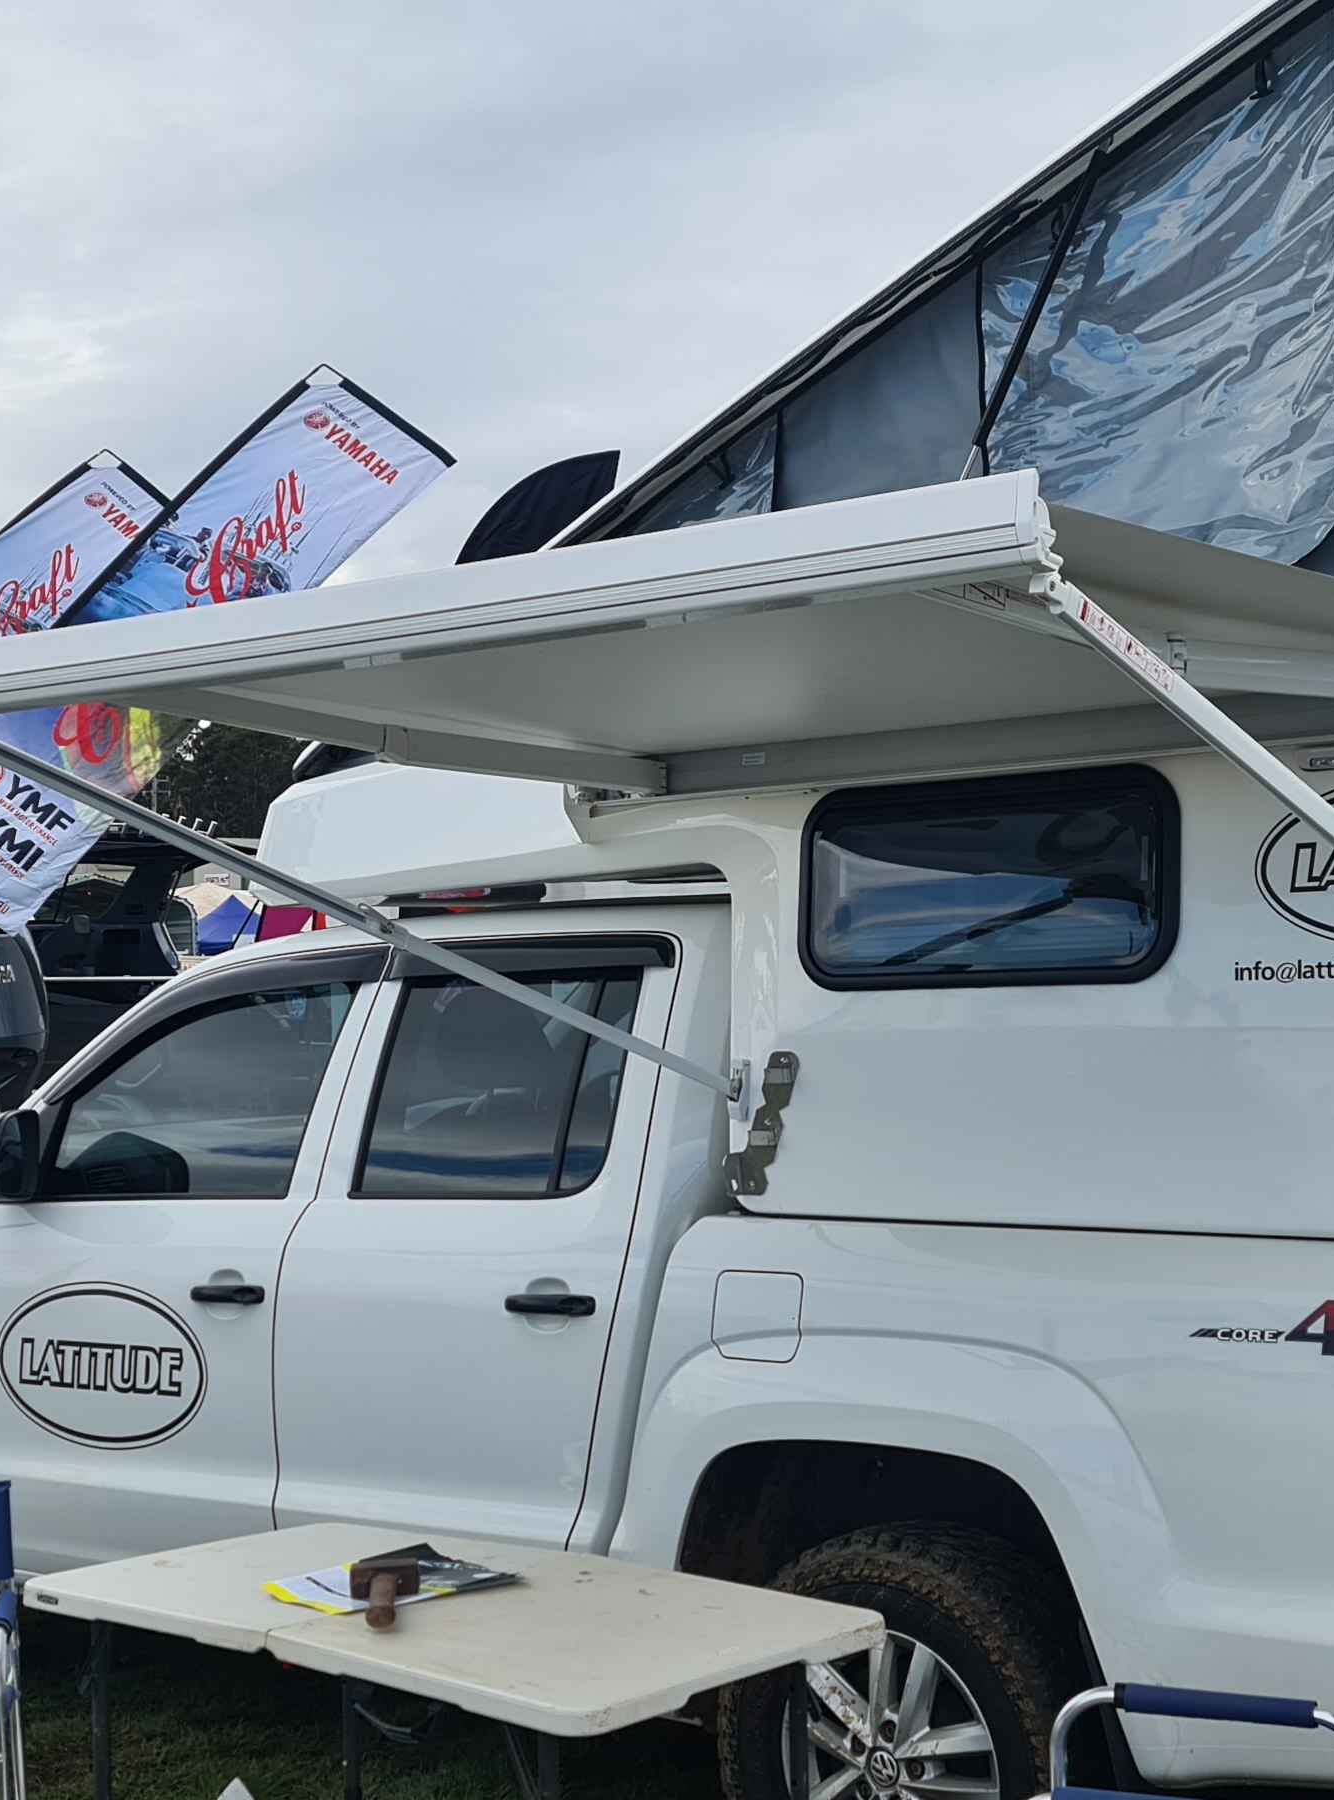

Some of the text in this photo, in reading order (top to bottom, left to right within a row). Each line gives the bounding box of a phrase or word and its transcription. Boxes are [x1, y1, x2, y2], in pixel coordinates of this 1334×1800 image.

[324, 423, 400, 486] YAMAHA
[350, 420, 362, 431] BY
[101, 502, 142, 540] YAM
[185, 469, 306, 604] Craft
[6, 774, 76, 832] YMF
[1216, 1327, 1279, 1344] CORE
[19, 1336, 184, 1398] LATITUDE
